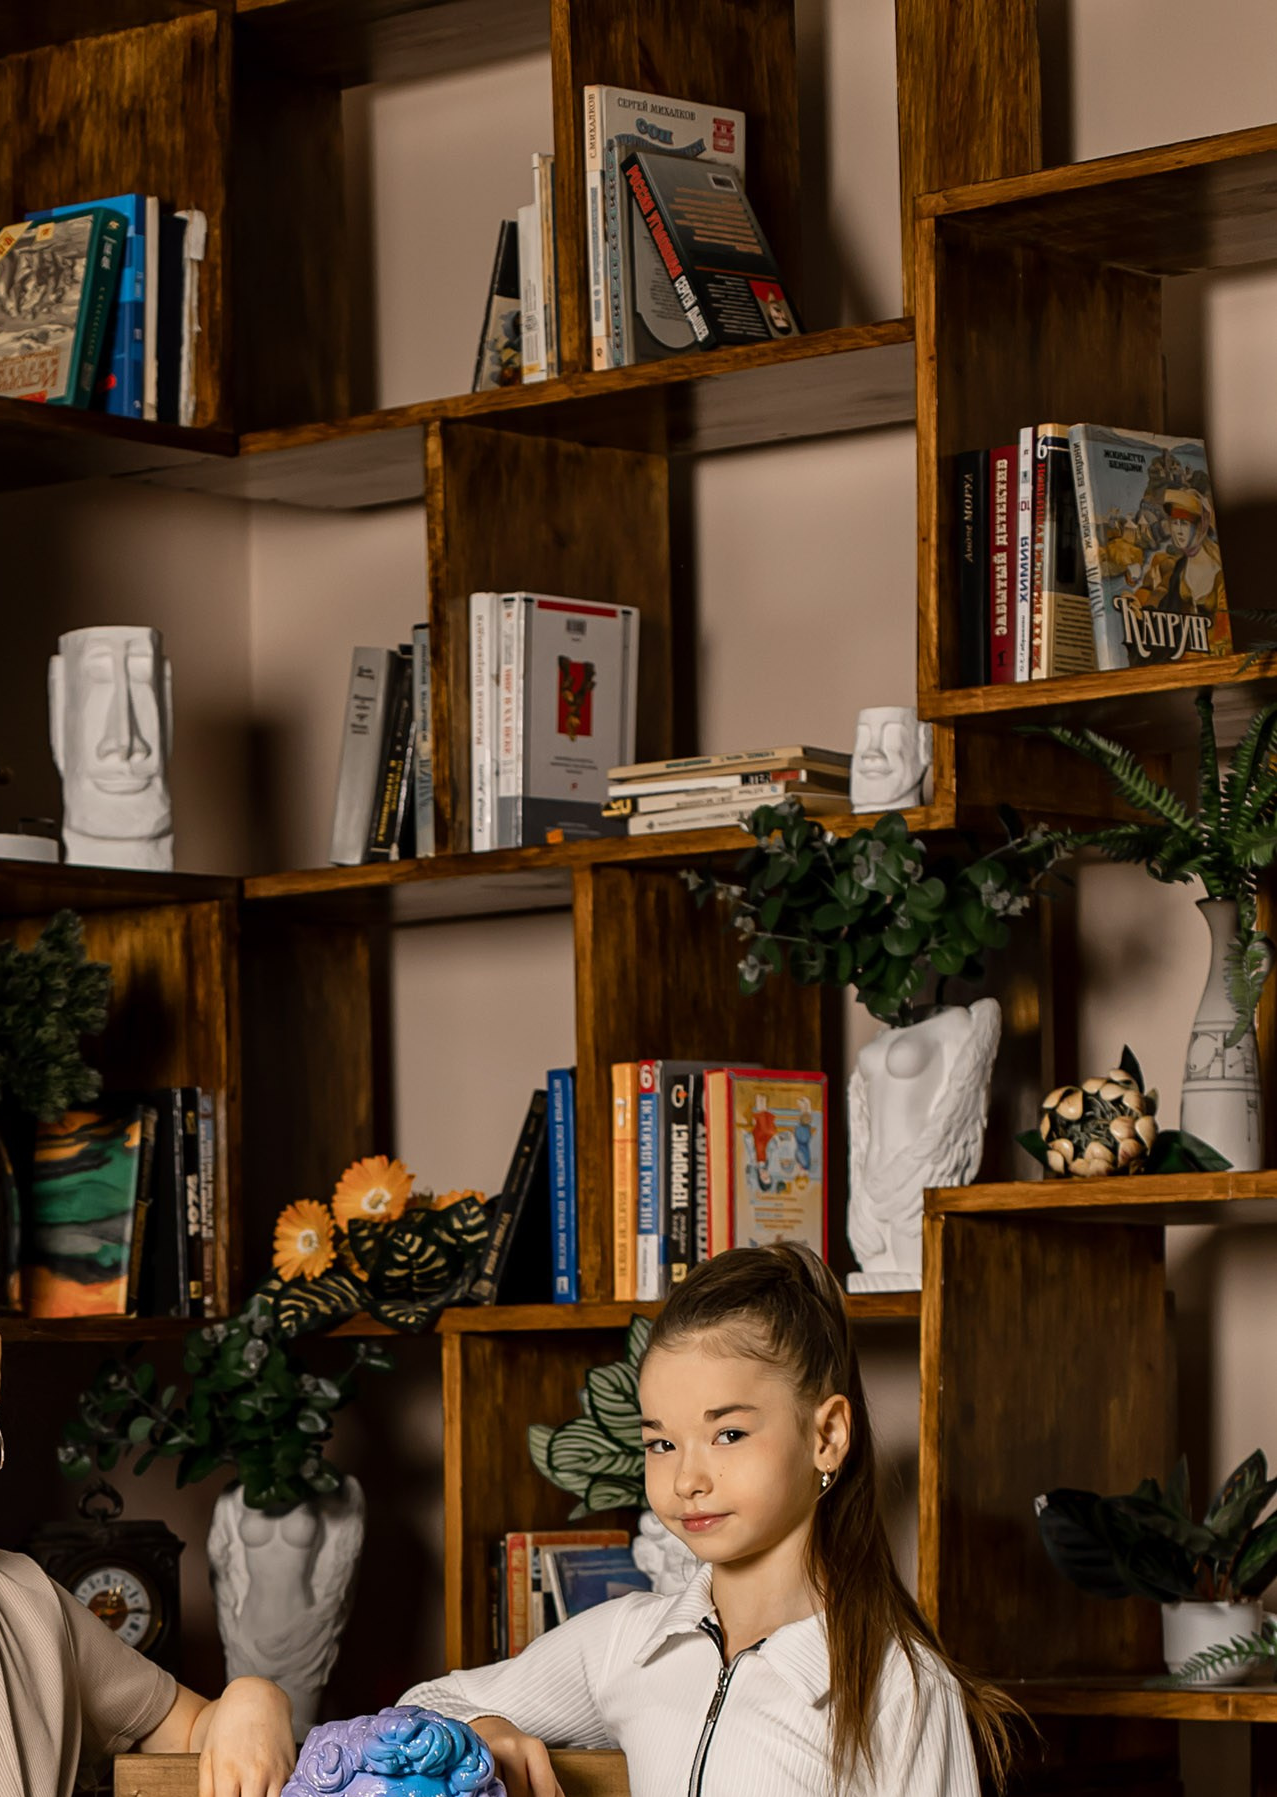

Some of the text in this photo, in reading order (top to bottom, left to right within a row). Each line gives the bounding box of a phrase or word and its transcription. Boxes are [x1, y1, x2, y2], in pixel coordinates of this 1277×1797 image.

[617, 95, 697, 122] СЕРГЕЙ МИХАЛКОВ
[625, 163, 656, 220] РОССИЯ
[992, 458, 1009, 637] ЗАБЫТЫЙ ДЕТЕКТИВ
[1018, 536, 1030, 603] ХИМИЯ
[1113, 594, 1213, 661] КАТРИН
[640, 1064, 653, 1089] 6
[639, 1098, 654, 1230] ИСТОРИЯ РОССИИ
[671, 1122, 690, 1209] ТЕРРОРИСТ
[186, 1172, 200, 1237] 1074
